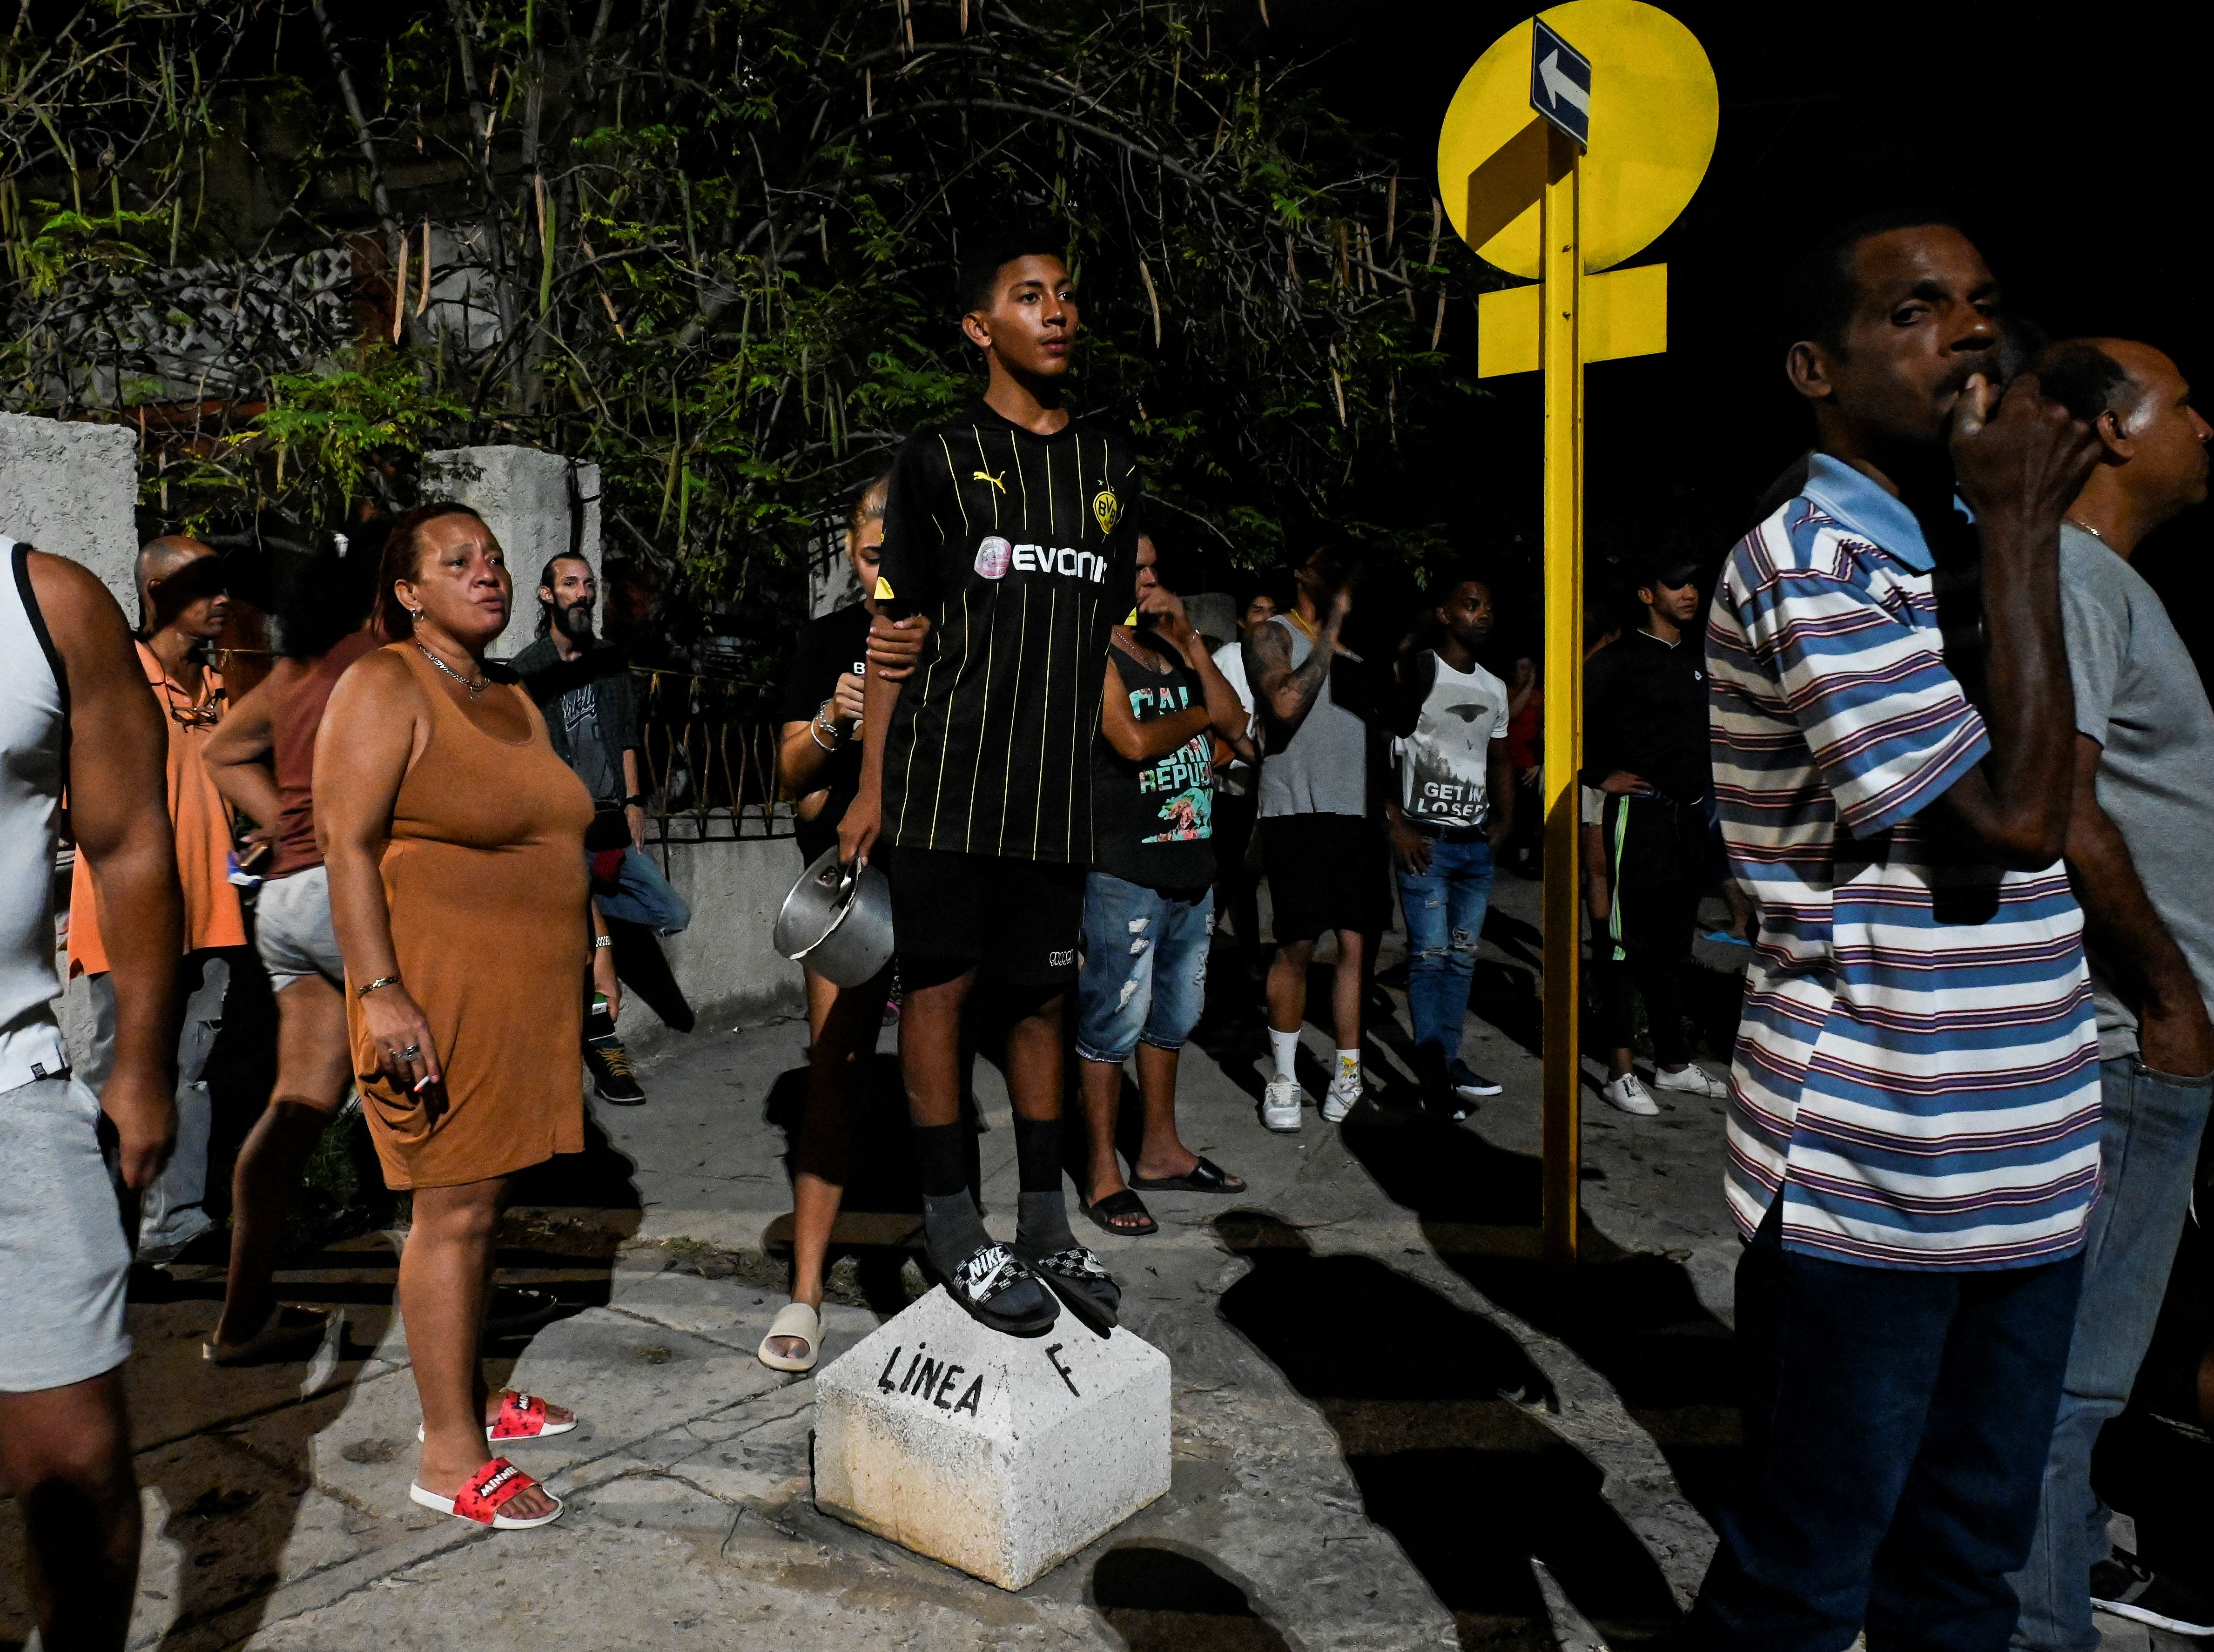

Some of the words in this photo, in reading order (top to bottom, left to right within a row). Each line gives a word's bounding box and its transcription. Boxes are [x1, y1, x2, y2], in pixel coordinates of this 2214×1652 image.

[1098, 496, 1116, 525] BVB
[1424, 782, 1464, 801] GET
[1468, 787, 1485, 802] IN
[968, 1246, 1008, 1281] NIKE
[1045, 1343, 1080, 1398] F
[481, 1466, 518, 1497] MINNIE
